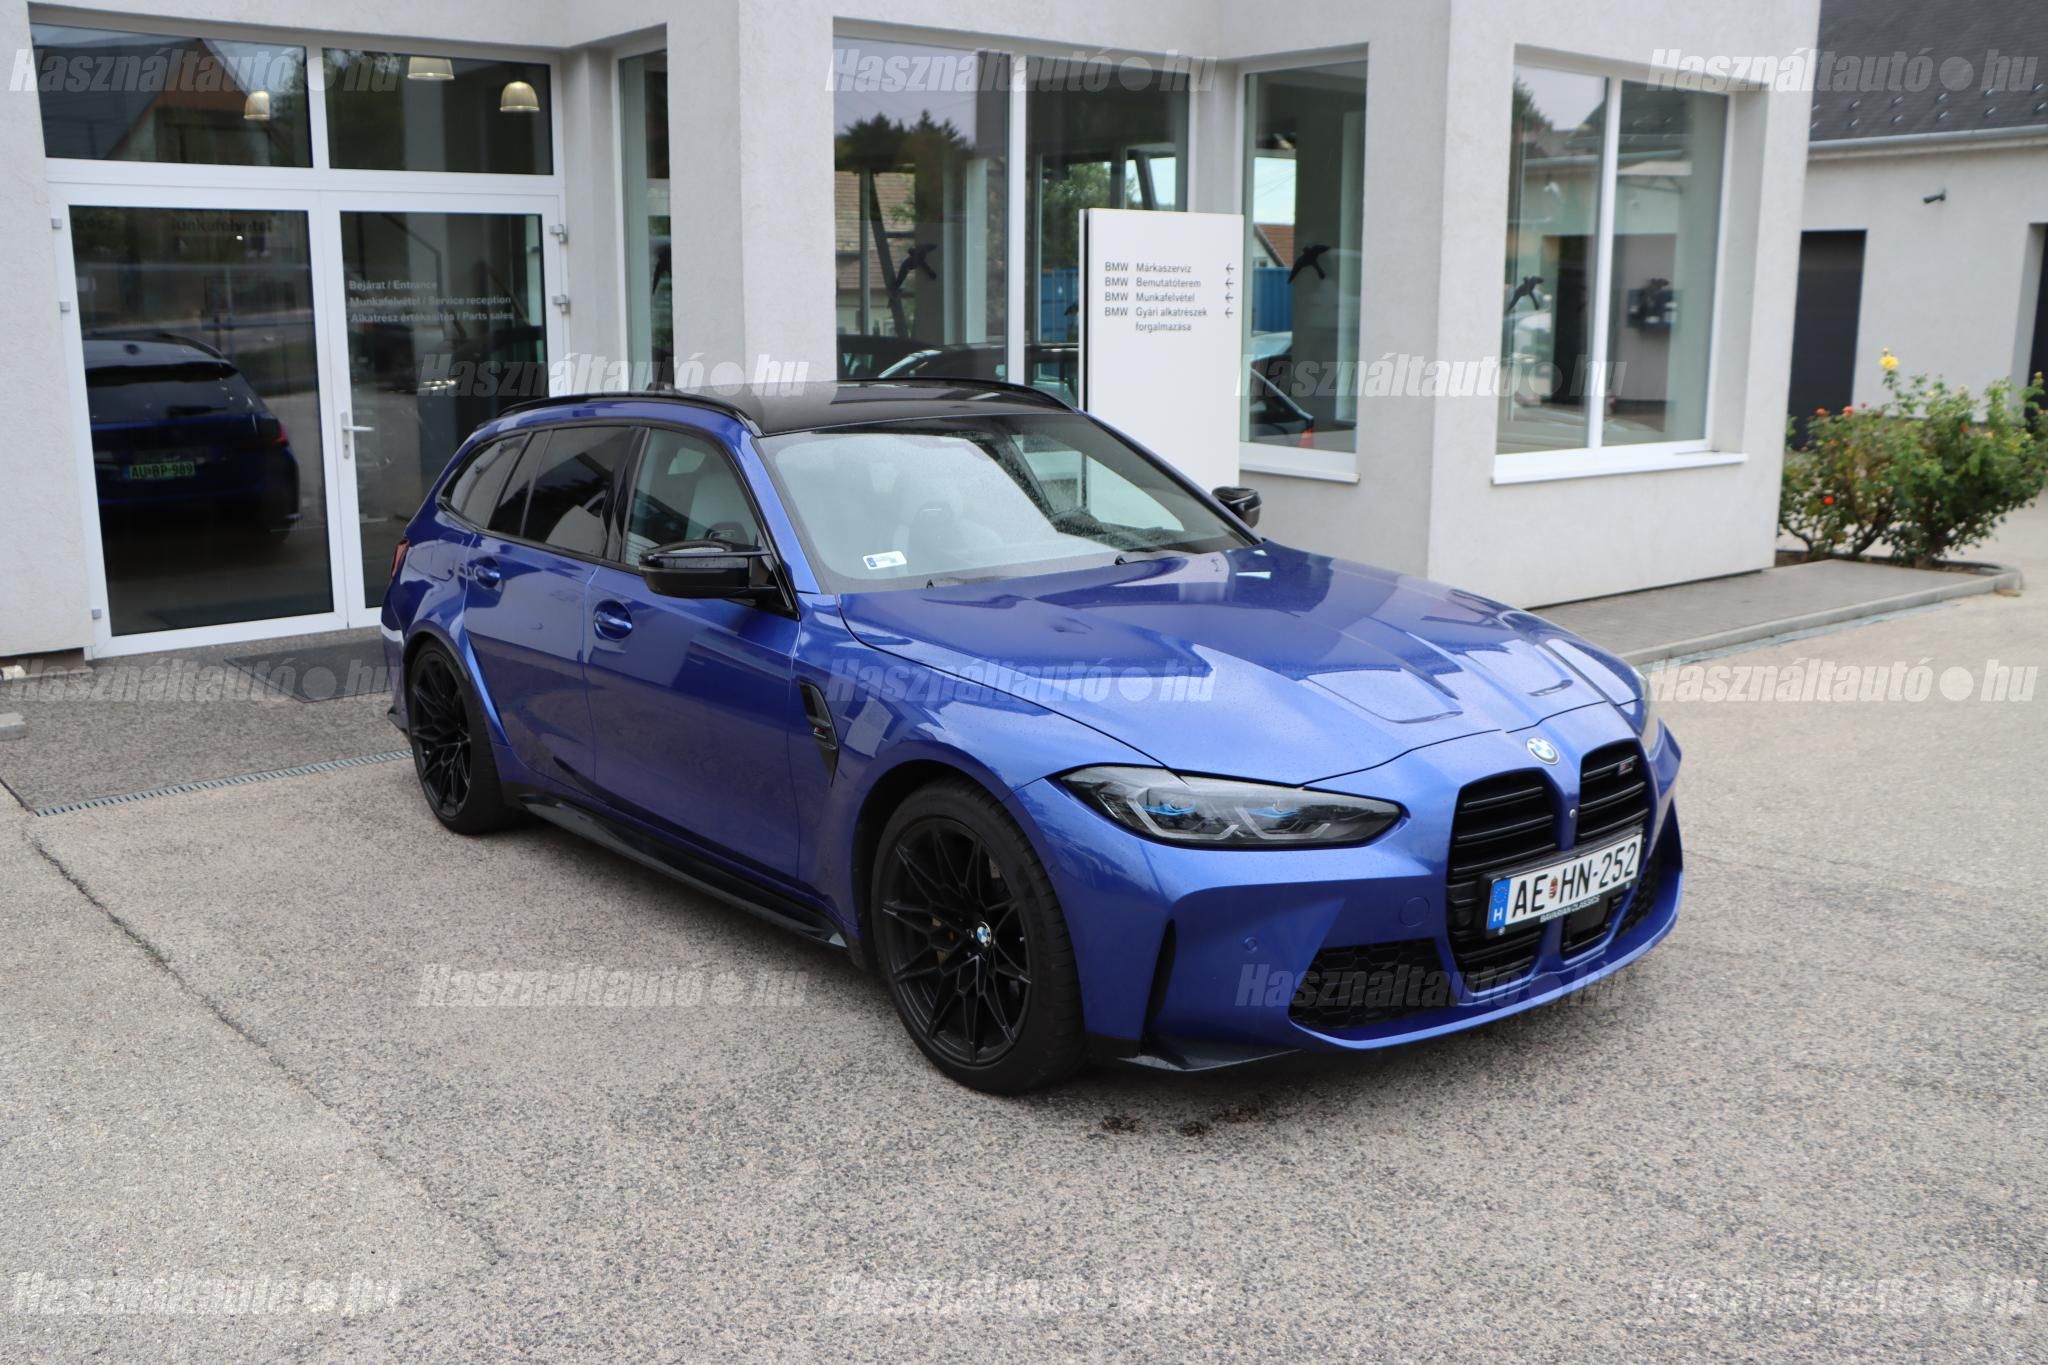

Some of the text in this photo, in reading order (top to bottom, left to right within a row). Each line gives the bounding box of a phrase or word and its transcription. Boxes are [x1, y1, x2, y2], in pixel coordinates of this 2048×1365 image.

[1104, 261, 1129, 272] BMW
[393, 279, 437, 290] Entrance
[1104, 276, 1129, 287] BMW
[429, 295, 465, 305] Service
[466, 295, 512, 307] reception
[1104, 291, 1129, 302] BMW
[462, 311, 488, 321] Parts
[1104, 306, 1129, 317] BMW
[1512, 873, 1549, 918] AE
[1558, 841, 1638, 903] HN-252
